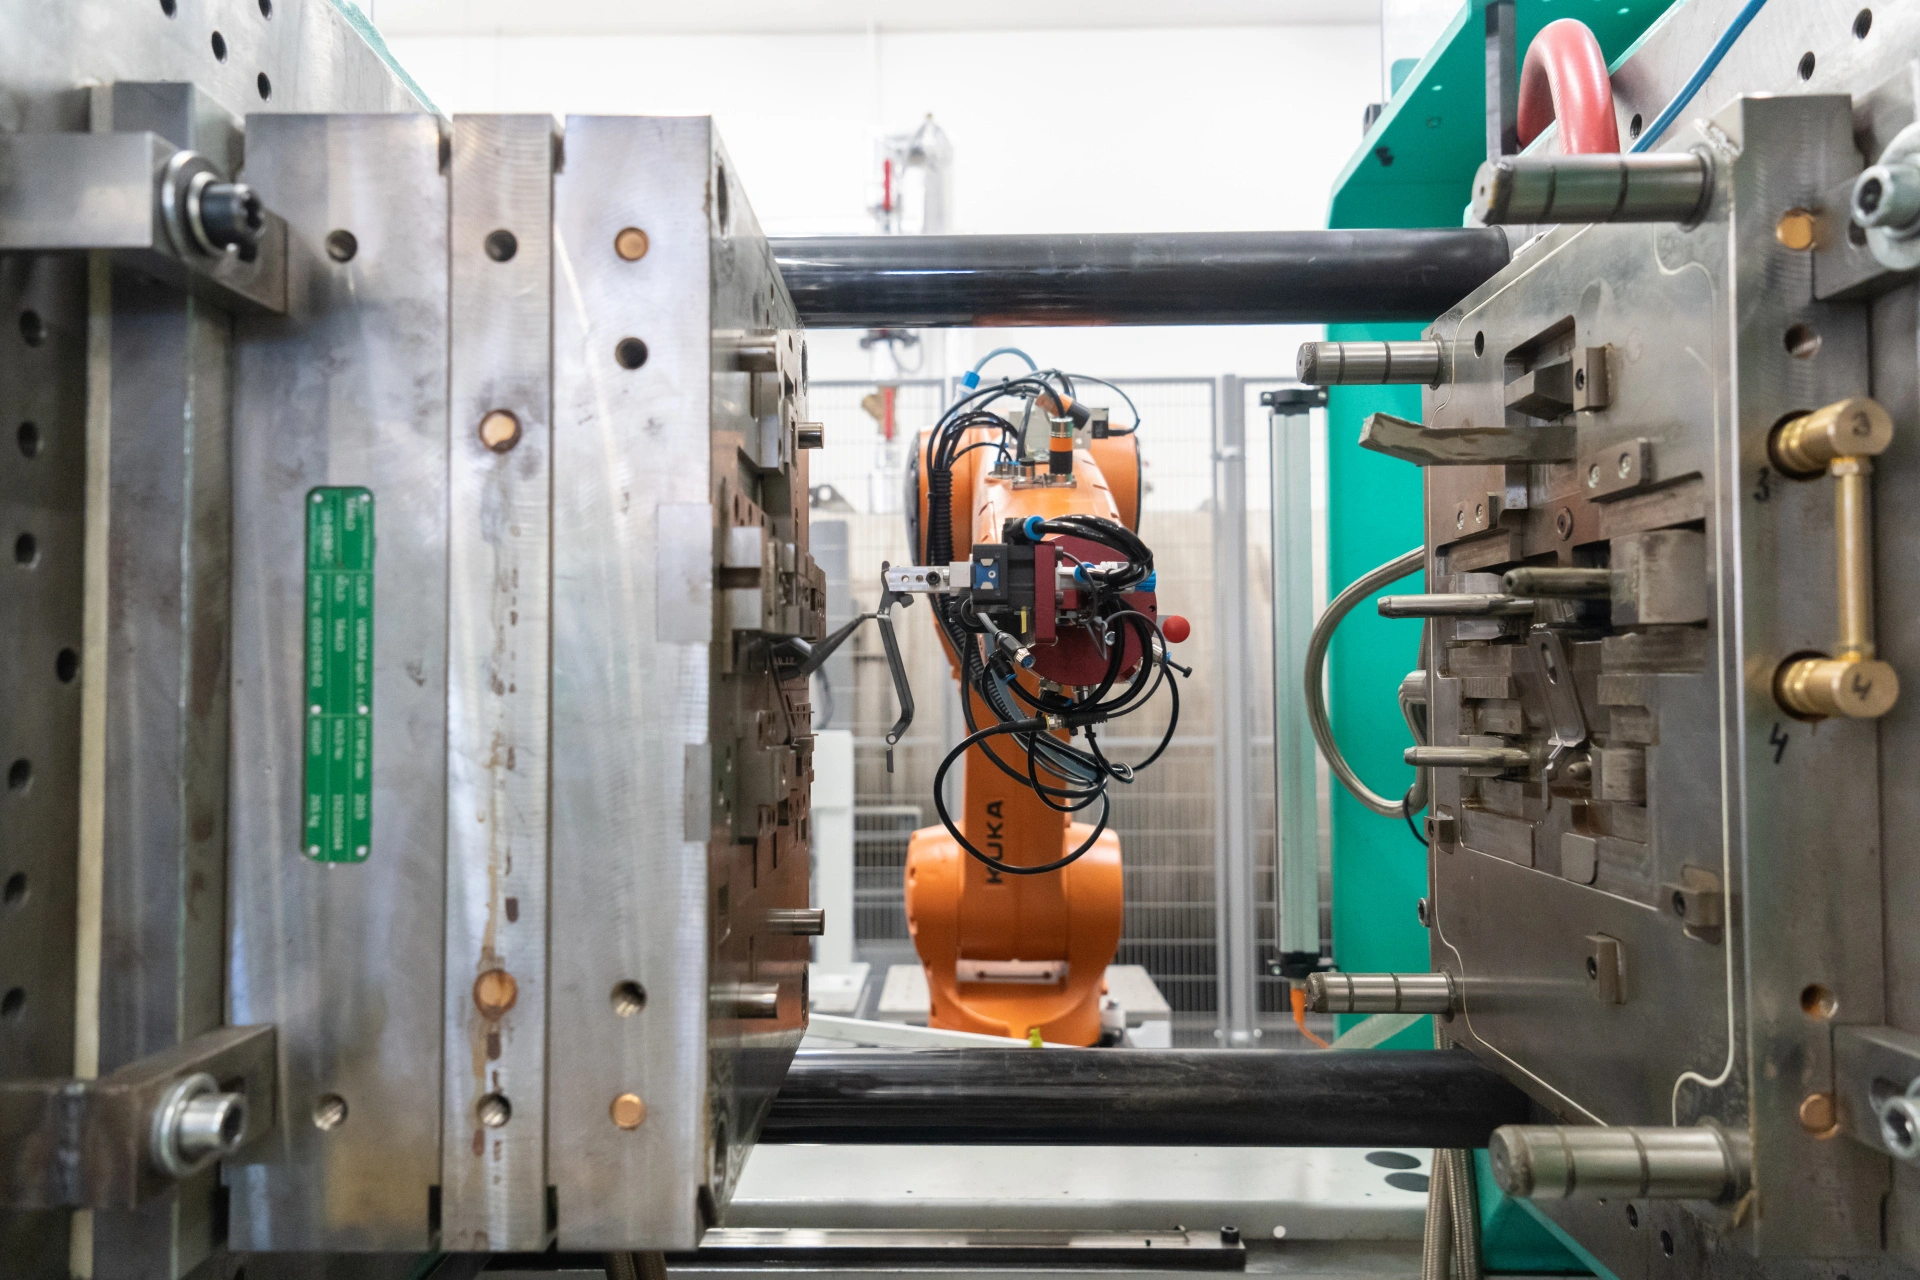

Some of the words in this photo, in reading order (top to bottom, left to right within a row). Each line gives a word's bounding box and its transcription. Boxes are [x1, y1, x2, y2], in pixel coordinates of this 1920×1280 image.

[1754, 467, 1770, 503] 3
[1852, 673, 1872, 700] 4
[1769, 722, 1788, 764] 4
[987, 801, 1003, 884] KUKA
